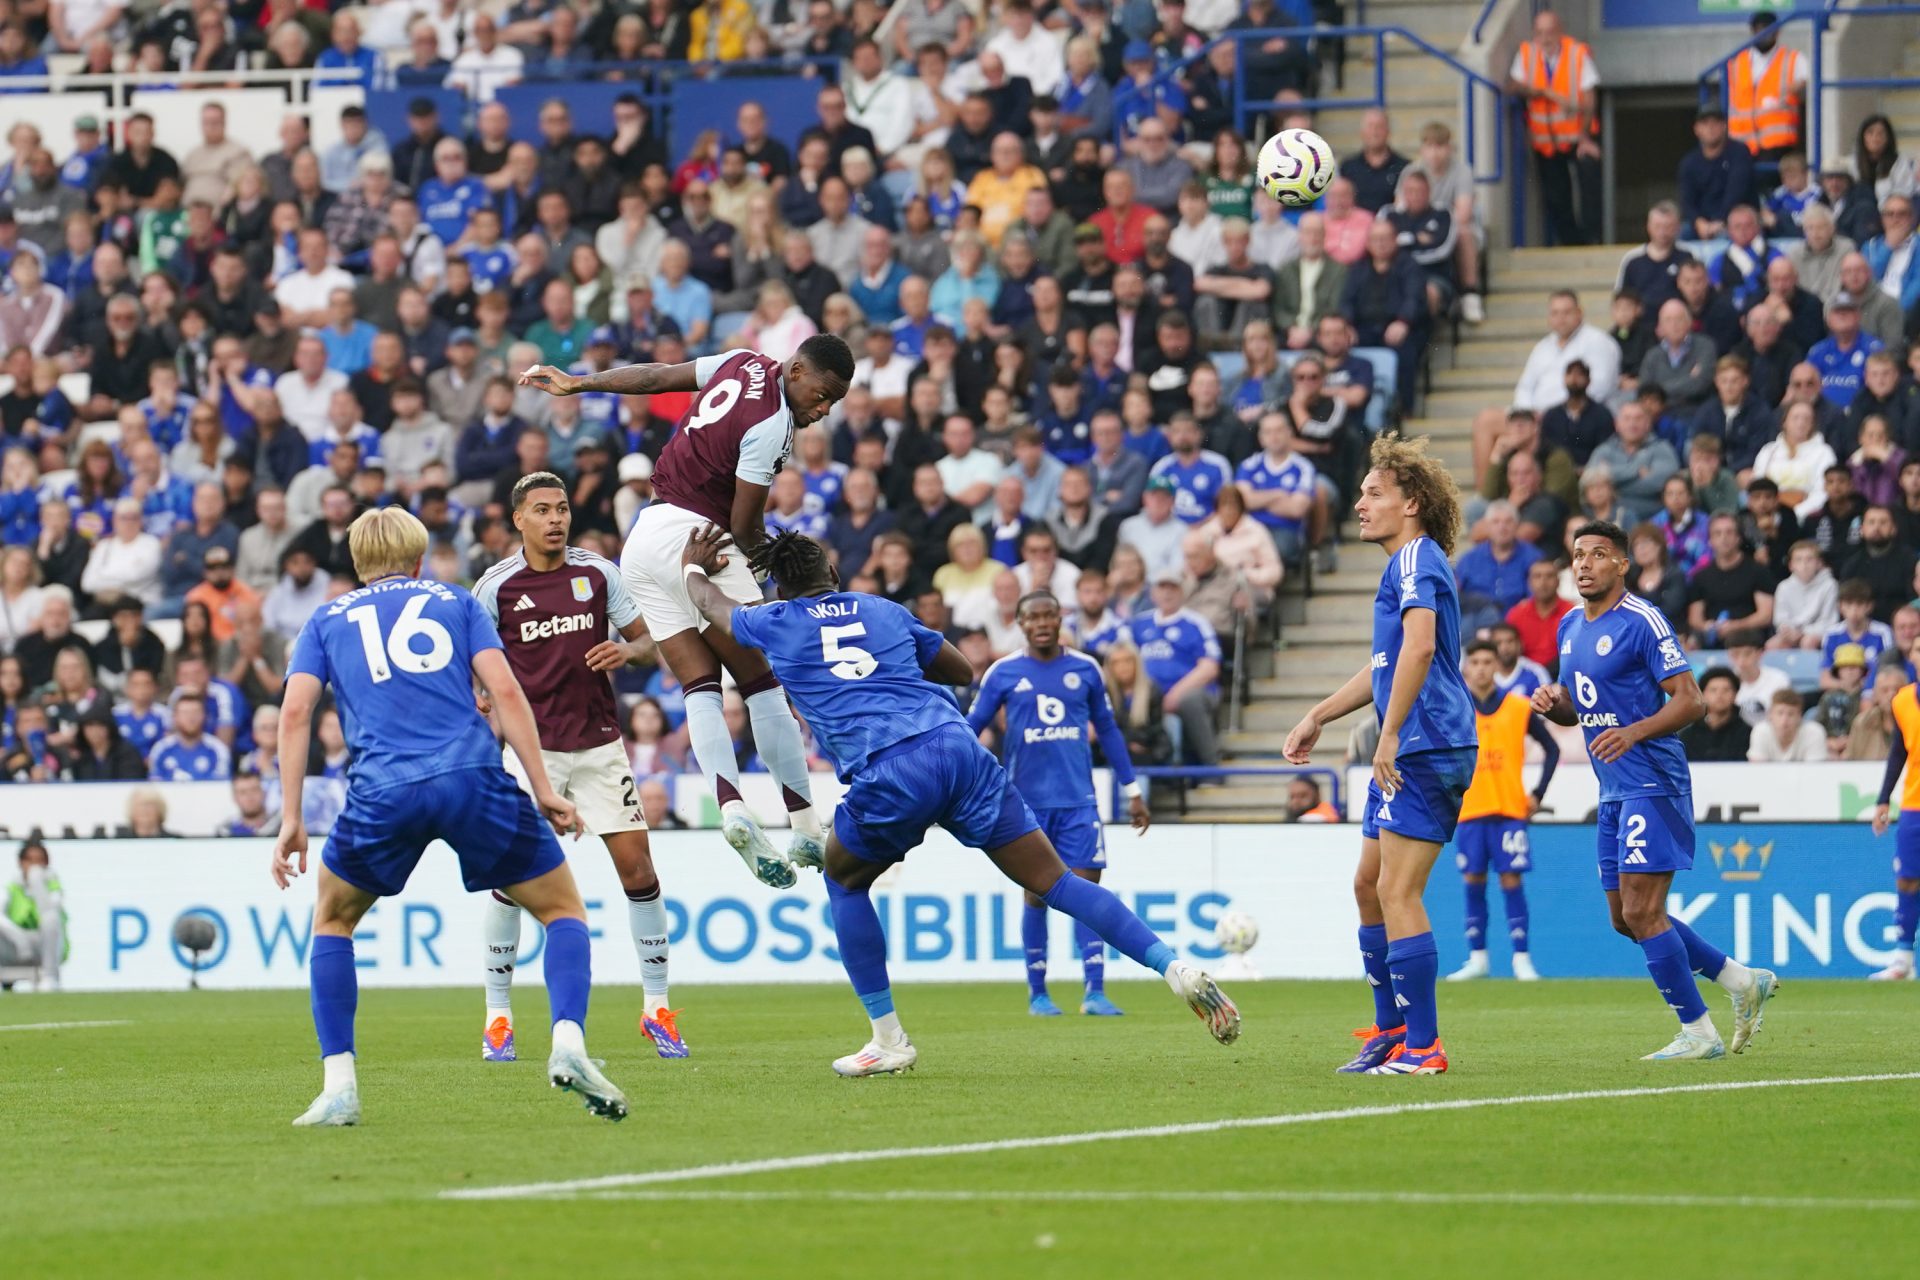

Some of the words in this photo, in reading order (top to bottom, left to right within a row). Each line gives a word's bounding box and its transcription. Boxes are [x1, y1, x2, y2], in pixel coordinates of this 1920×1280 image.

[684, 378, 743, 436] 9
[806, 600, 859, 619] OKOLI
[346, 593, 454, 684] 16
[520, 612, 594, 643] Betano
[820, 621, 880, 680] 5
[1023, 726, 1080, 744] BC.GAME
[1626, 814, 1647, 848] 2
[488, 943, 515, 955] 1874
[638, 937, 667, 947] 1874
